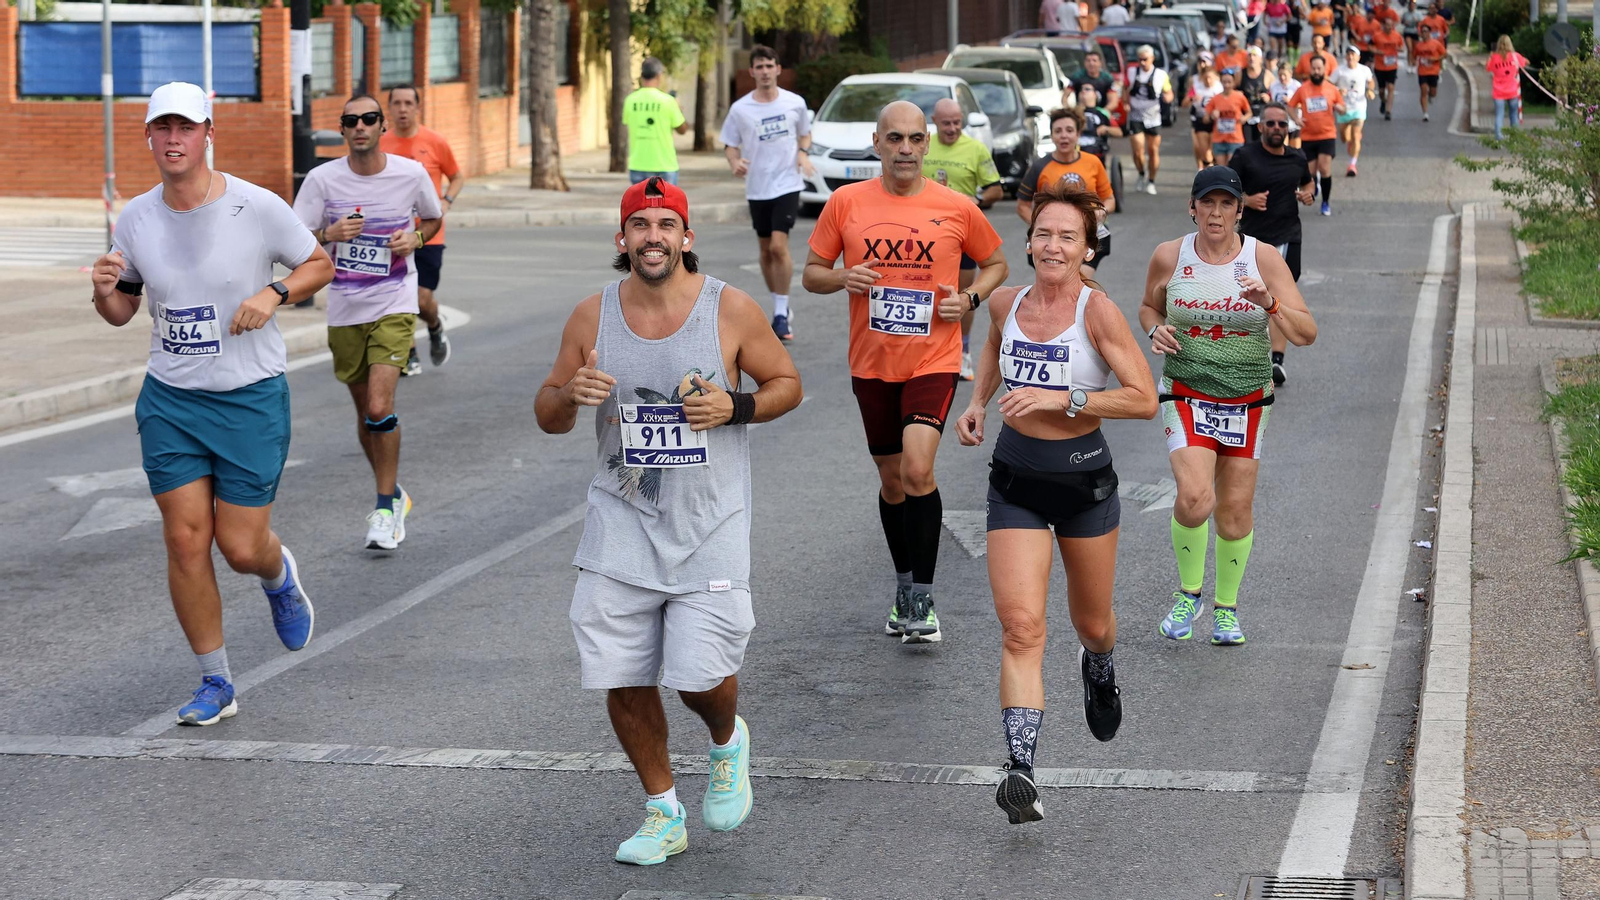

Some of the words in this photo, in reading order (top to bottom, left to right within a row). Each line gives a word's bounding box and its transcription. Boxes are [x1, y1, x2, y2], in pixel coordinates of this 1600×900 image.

[350, 246, 378, 261] 869
[862, 238, 937, 264] XXIX
[884, 303, 917, 321] 735
[1174, 296, 1256, 313] maratón
[1193, 314, 1232, 322] JEREZ
[169, 324, 203, 341] 664
[1013, 359, 1050, 383] 776
[641, 425, 682, 447] 911
